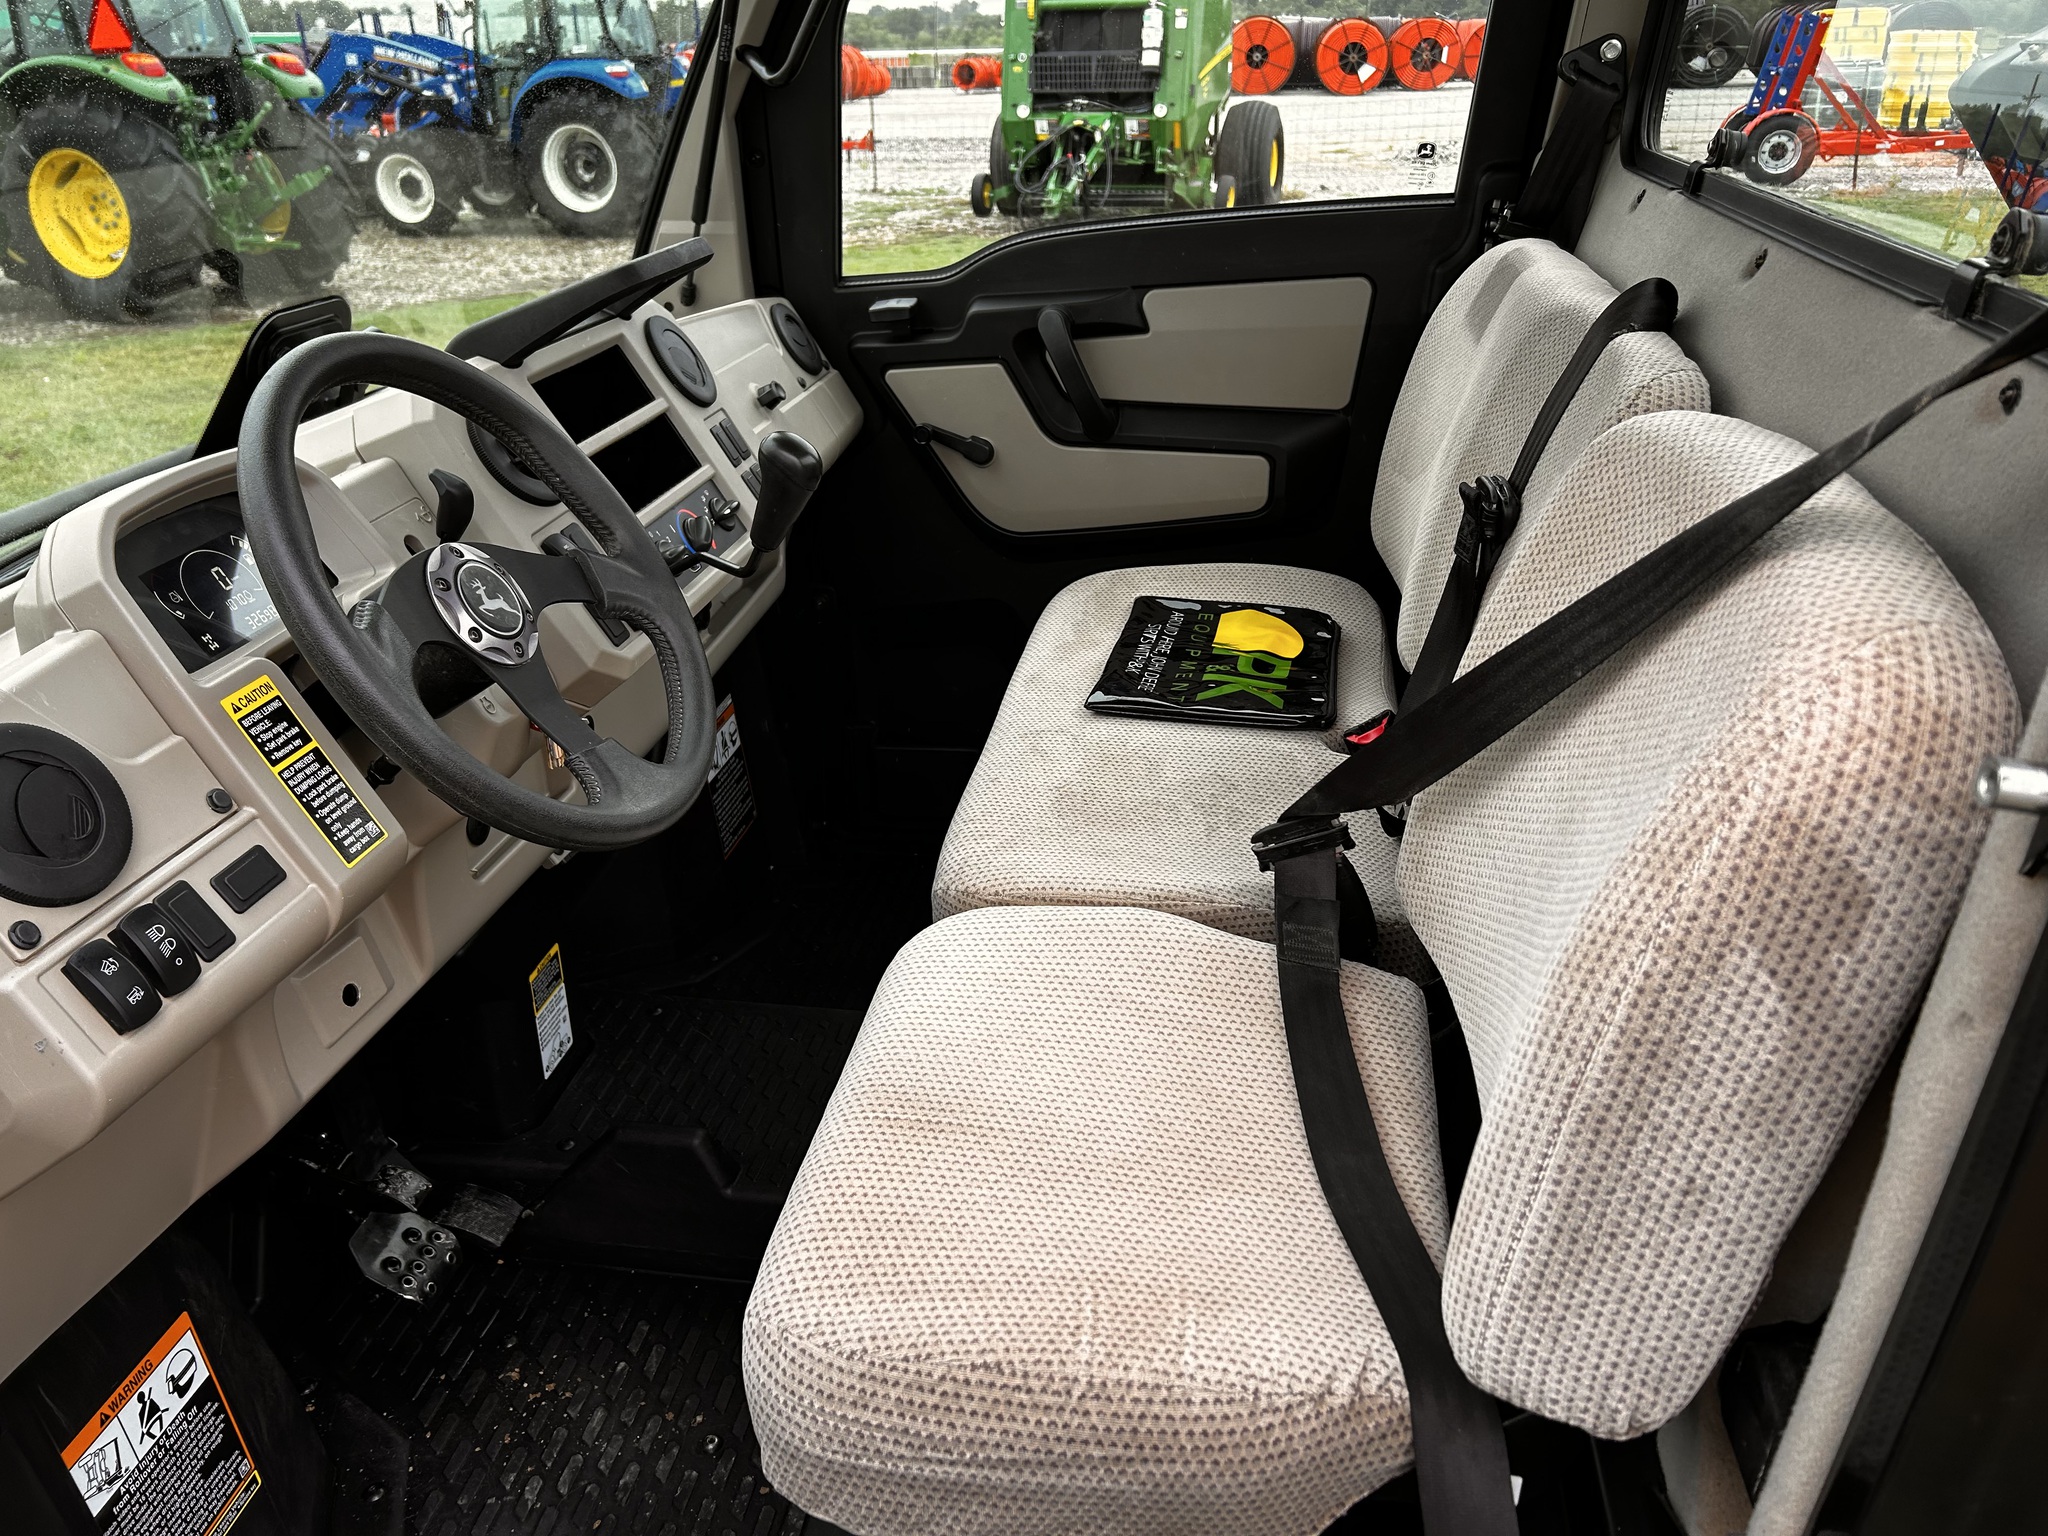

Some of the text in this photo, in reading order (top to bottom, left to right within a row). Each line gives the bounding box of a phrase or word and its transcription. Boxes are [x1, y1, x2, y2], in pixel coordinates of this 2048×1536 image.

[210, 566, 234, 590] 0
[238, 681, 274, 708] CAUTION
[241, 699, 282, 727] BEFORE LEAVING
[248, 719, 272, 736] VEHICLE:
[260, 721, 288, 742] Stop engine
[266, 726, 299, 750] Set park brake
[274, 738, 303, 759] Remove key
[281, 752, 316, 779] HELP PREVENT
[288, 762, 320, 787] INJURY WHEN
[294, 765, 332, 795] DUMPING LOADS
[304, 773, 339, 800] Lock park brake
[310, 781, 346, 808] before dumping
[318, 792, 349, 817] Operate dump
[330, 808, 342, 820] level
[340, 797, 357, 813] ground
[330, 821, 342, 833] only
[336, 827, 350, 839] Keep
[349, 841, 362, 854] cargo
[108, 1358, 153, 1413] WARNING
[113, 1492, 130, 1515] from
[129, 1457, 157, 1494] Rollover
[158, 1447, 165, 1459] or
[165, 1420, 188, 1449] Falling
[187, 1405, 197, 1421] Off
[117, 1503, 131, 1522] video
[130, 1491, 140, 1505] and
[140, 1477, 151, 1493] read
[150, 1449, 173, 1479] operator's
[173, 1428, 189, 1451] manual
[188, 1412, 203, 1430] before
[202, 1401, 212, 1413] use.
[120, 1411, 185, 1495] Avoid Injury or Death
